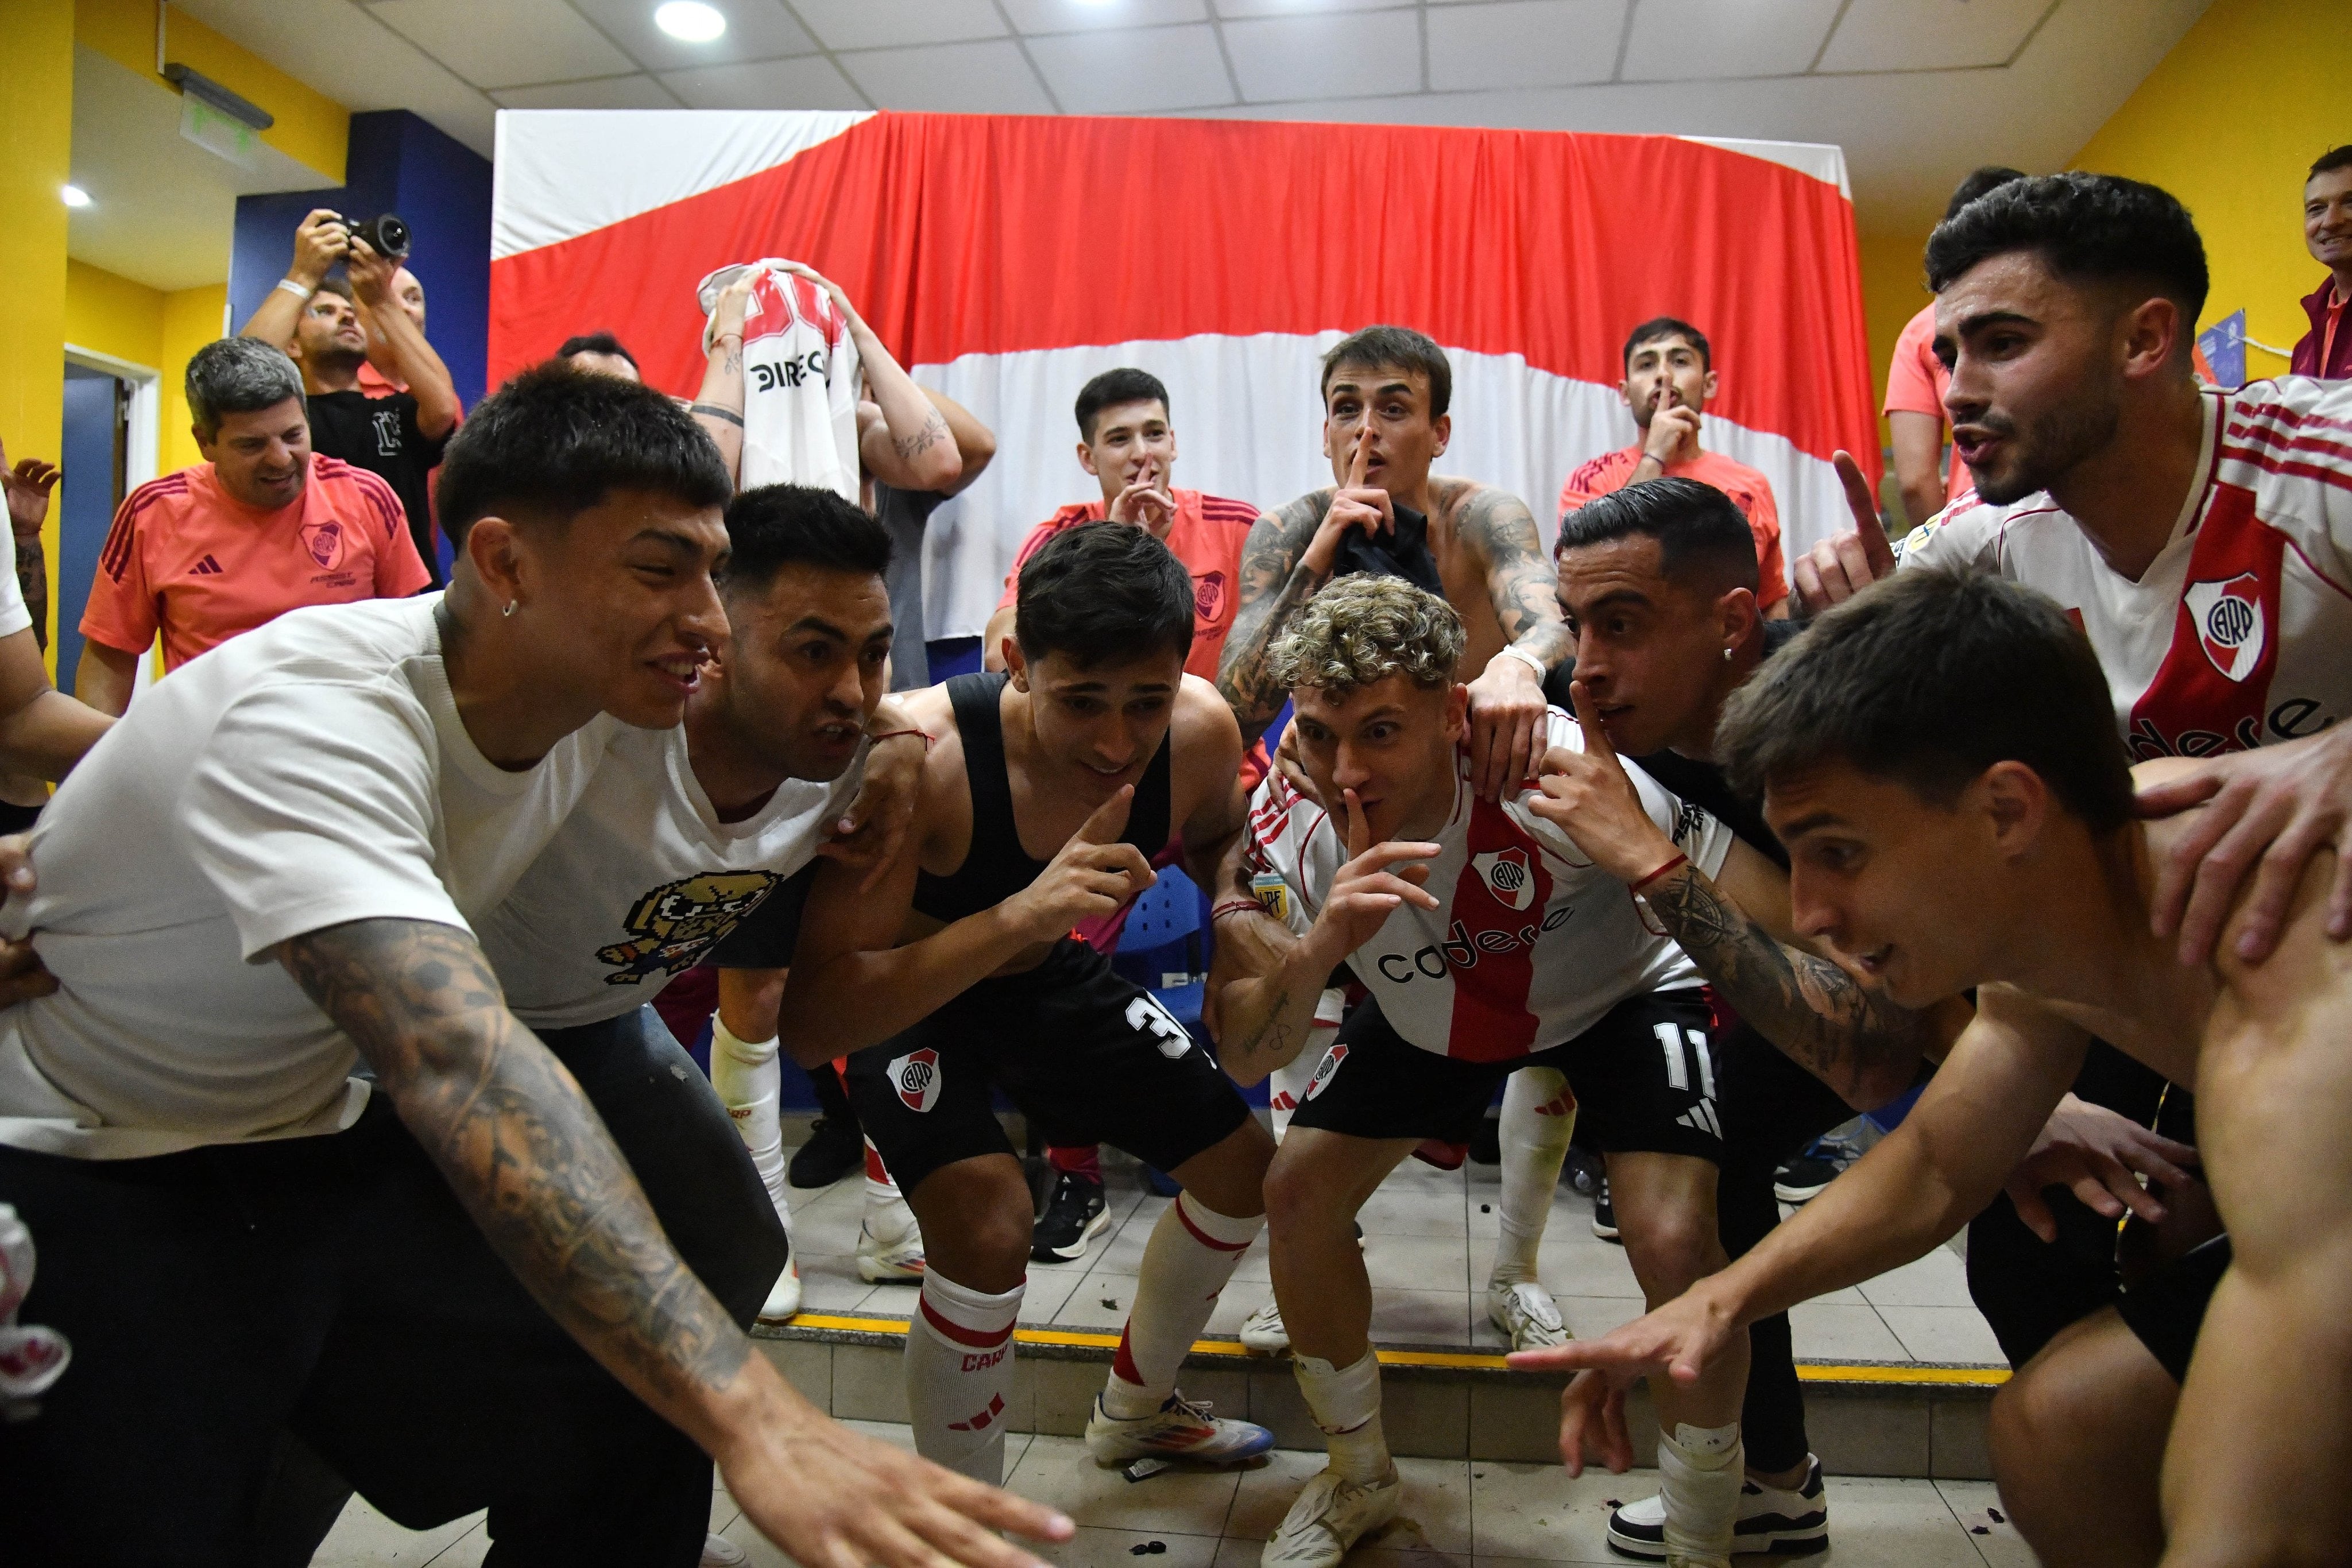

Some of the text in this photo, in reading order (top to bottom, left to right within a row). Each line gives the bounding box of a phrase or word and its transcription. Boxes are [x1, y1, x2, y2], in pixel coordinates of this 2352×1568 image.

[750, 351, 830, 392] DIREC
[2208, 598, 2253, 645] CARP
[2126, 698, 2336, 762] dere
[1491, 862, 1525, 890] CARP
[1378, 907, 1575, 984] codere
[1125, 988, 1217, 1070] 3
[901, 1062, 933, 1092] CARP
[1653, 1021, 1717, 1102] 11
